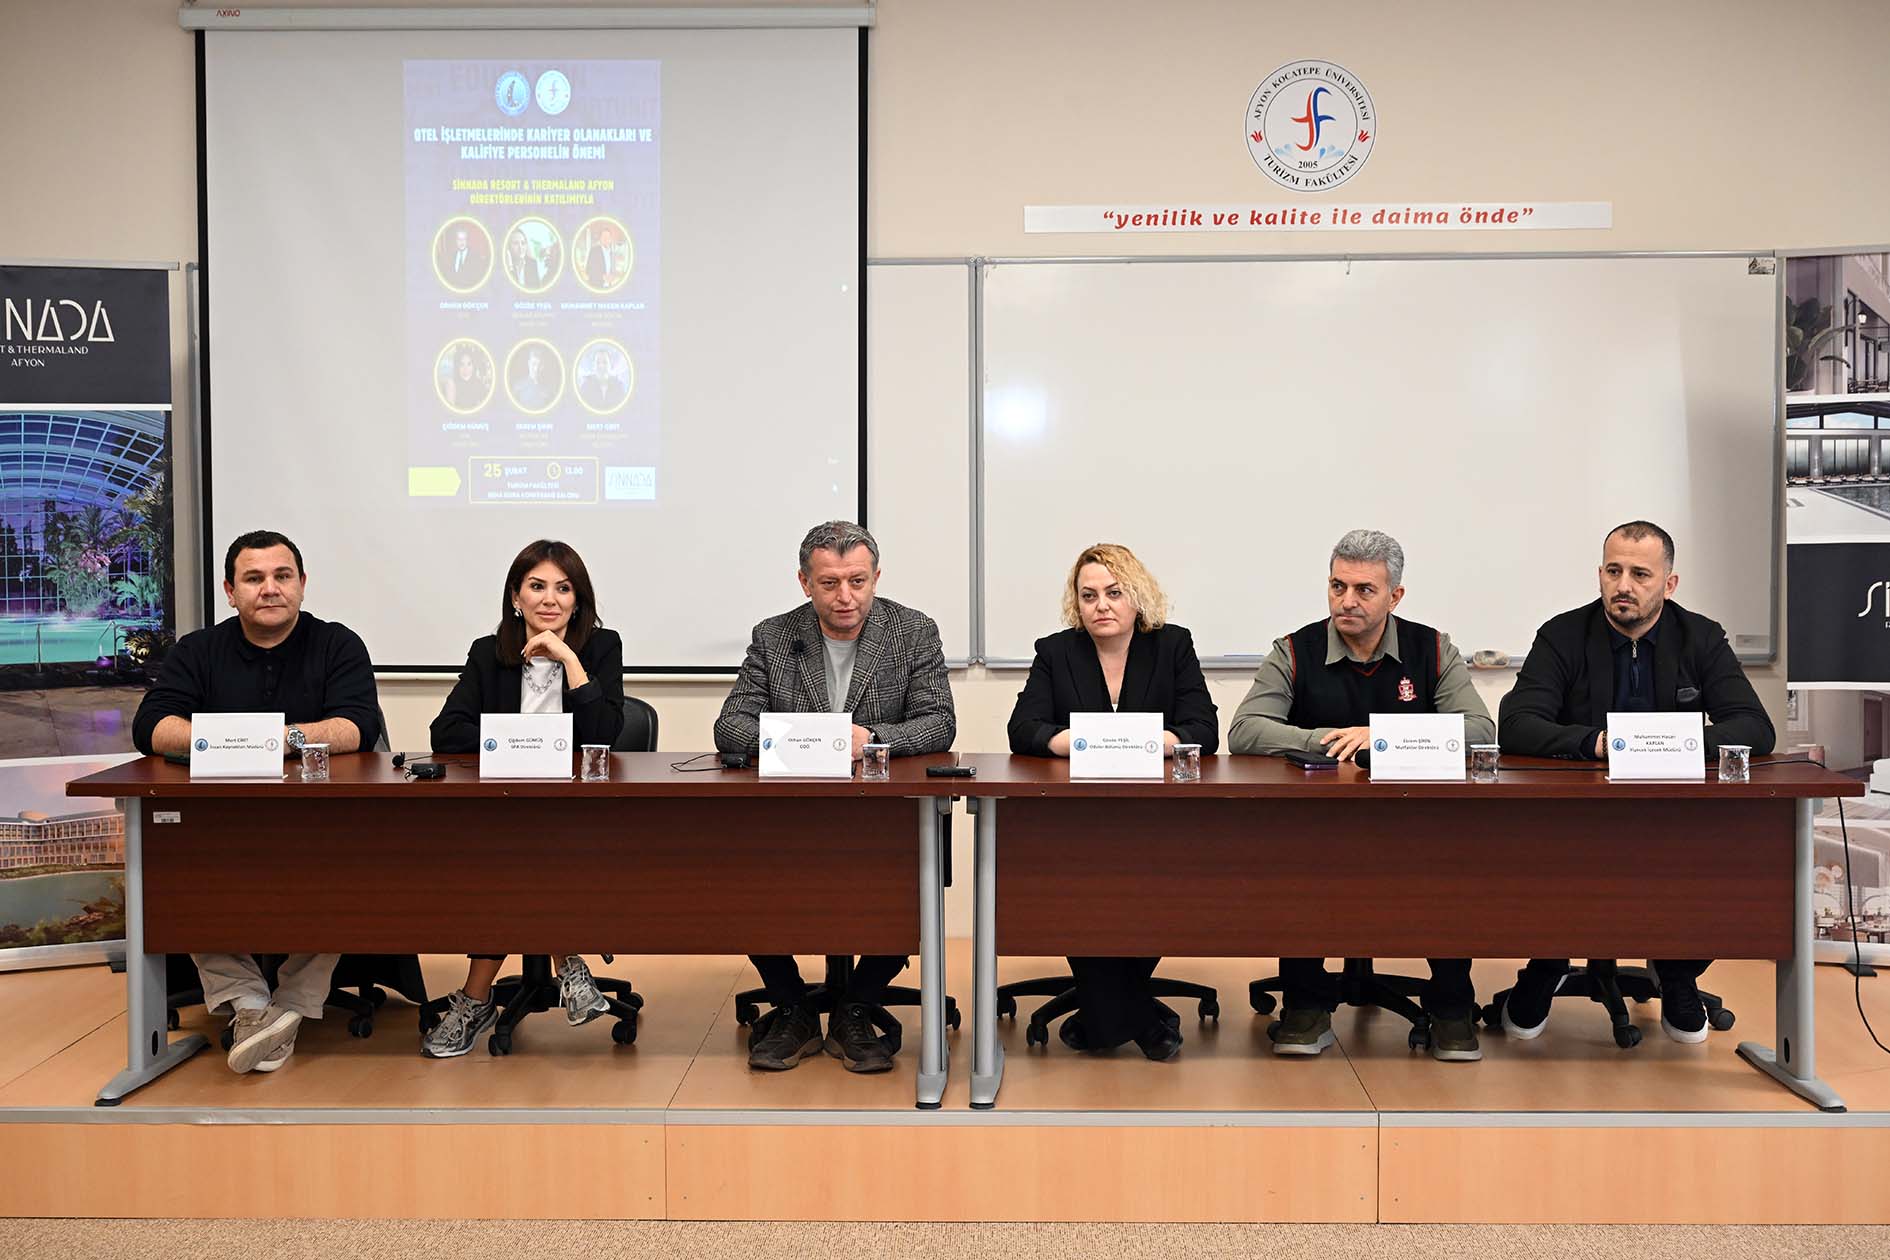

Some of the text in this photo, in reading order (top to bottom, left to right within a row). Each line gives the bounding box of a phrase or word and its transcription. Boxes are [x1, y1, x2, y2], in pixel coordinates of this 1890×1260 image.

[1254, 67, 1371, 121] AFYON KOCATEPE ÜNİVERSİTESİ
[414, 125, 652, 144] OTEL İŞLETMELERİNDE KARİYER OLANAKLARI VE
[461, 144, 606, 160] KALİFİYE PERSONELİN ÖNEMİ
[1263, 154, 1359, 187] TURİZM FAKÜLTESİ
[1298, 161, 1318, 169] 2005
[587, 179, 614, 191] AFYON
[1212, 212, 1240, 226] ve
[1249, 209, 1322, 226] kalite
[1332, 208, 1362, 226] ile
[1371, 208, 1450, 226] daima
[7, 346, 16, 354] &
[17, 345, 89, 355] THERMALAND
[11, 358, 45, 367] AFYON
[484, 463, 502, 478] 25
